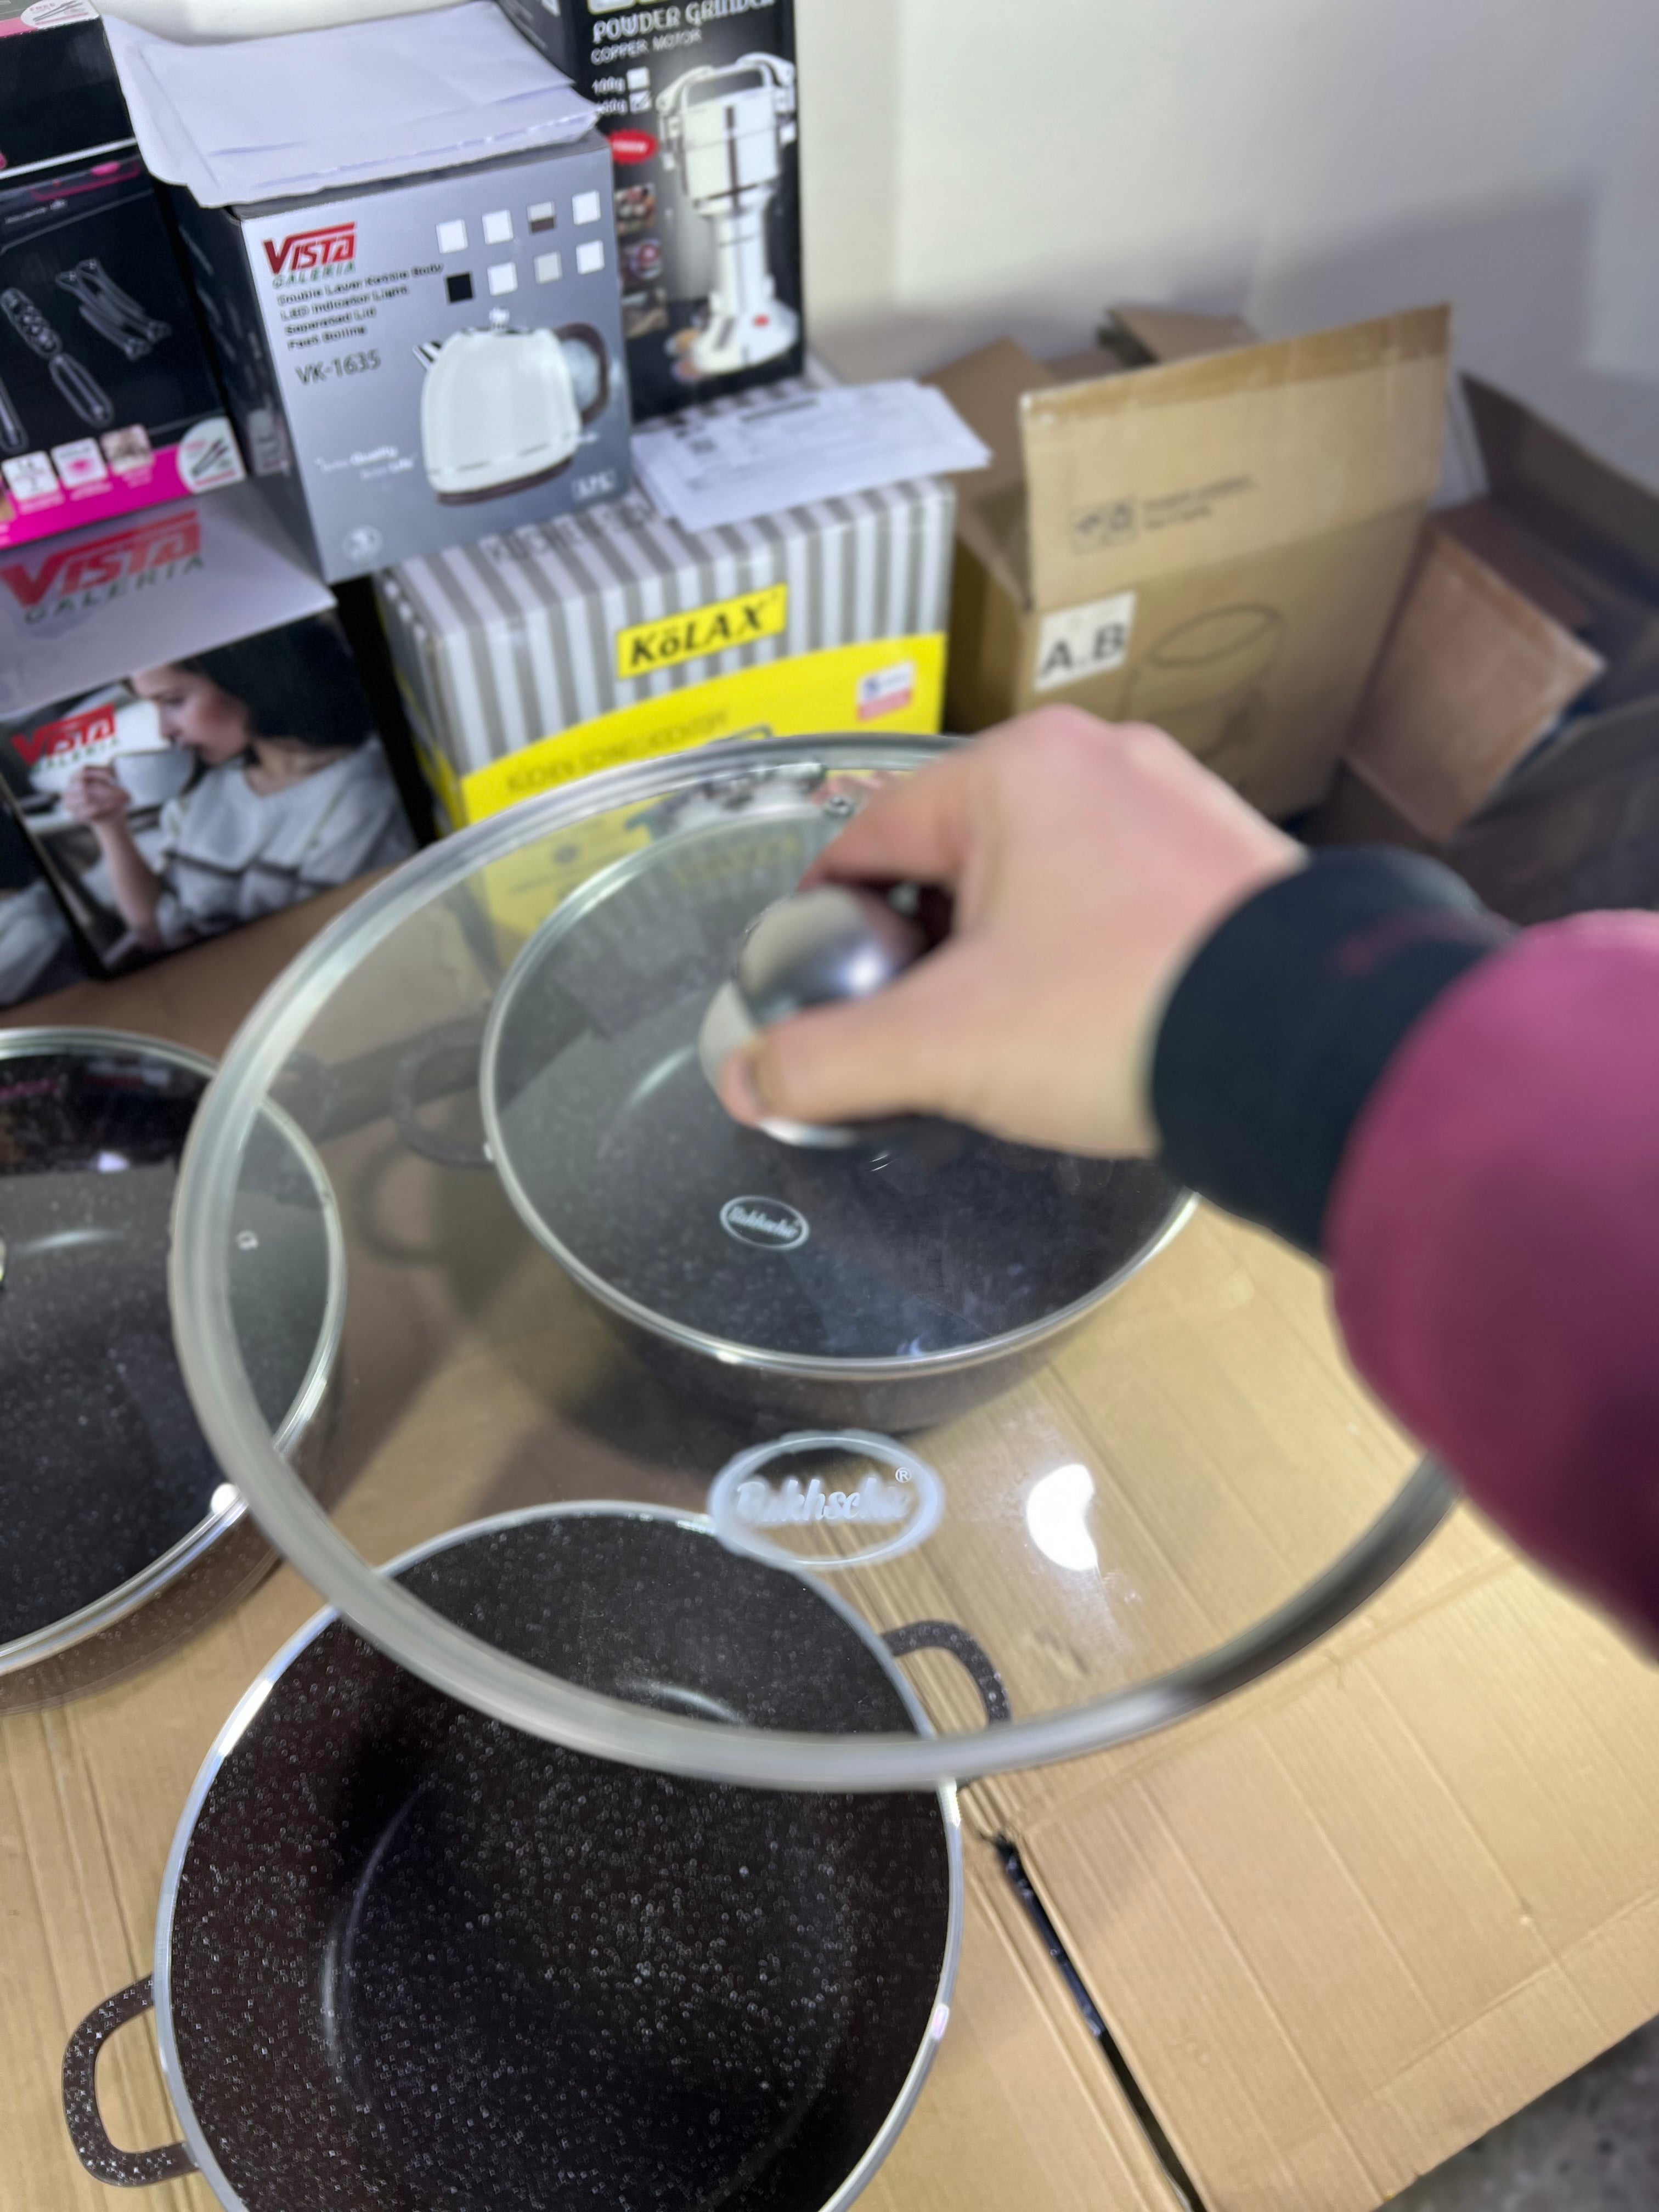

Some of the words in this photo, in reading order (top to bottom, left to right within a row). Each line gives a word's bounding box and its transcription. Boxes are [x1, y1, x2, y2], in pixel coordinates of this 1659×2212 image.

[592, 6, 681, 44] POWDER
[591, 38, 649, 65] COPPER
[652, 29, 702, 51] MOTOR
[272, 261, 356, 289] GALERIA
[280, 305, 309, 321] LED
[295, 349, 381, 385] VK-1635
